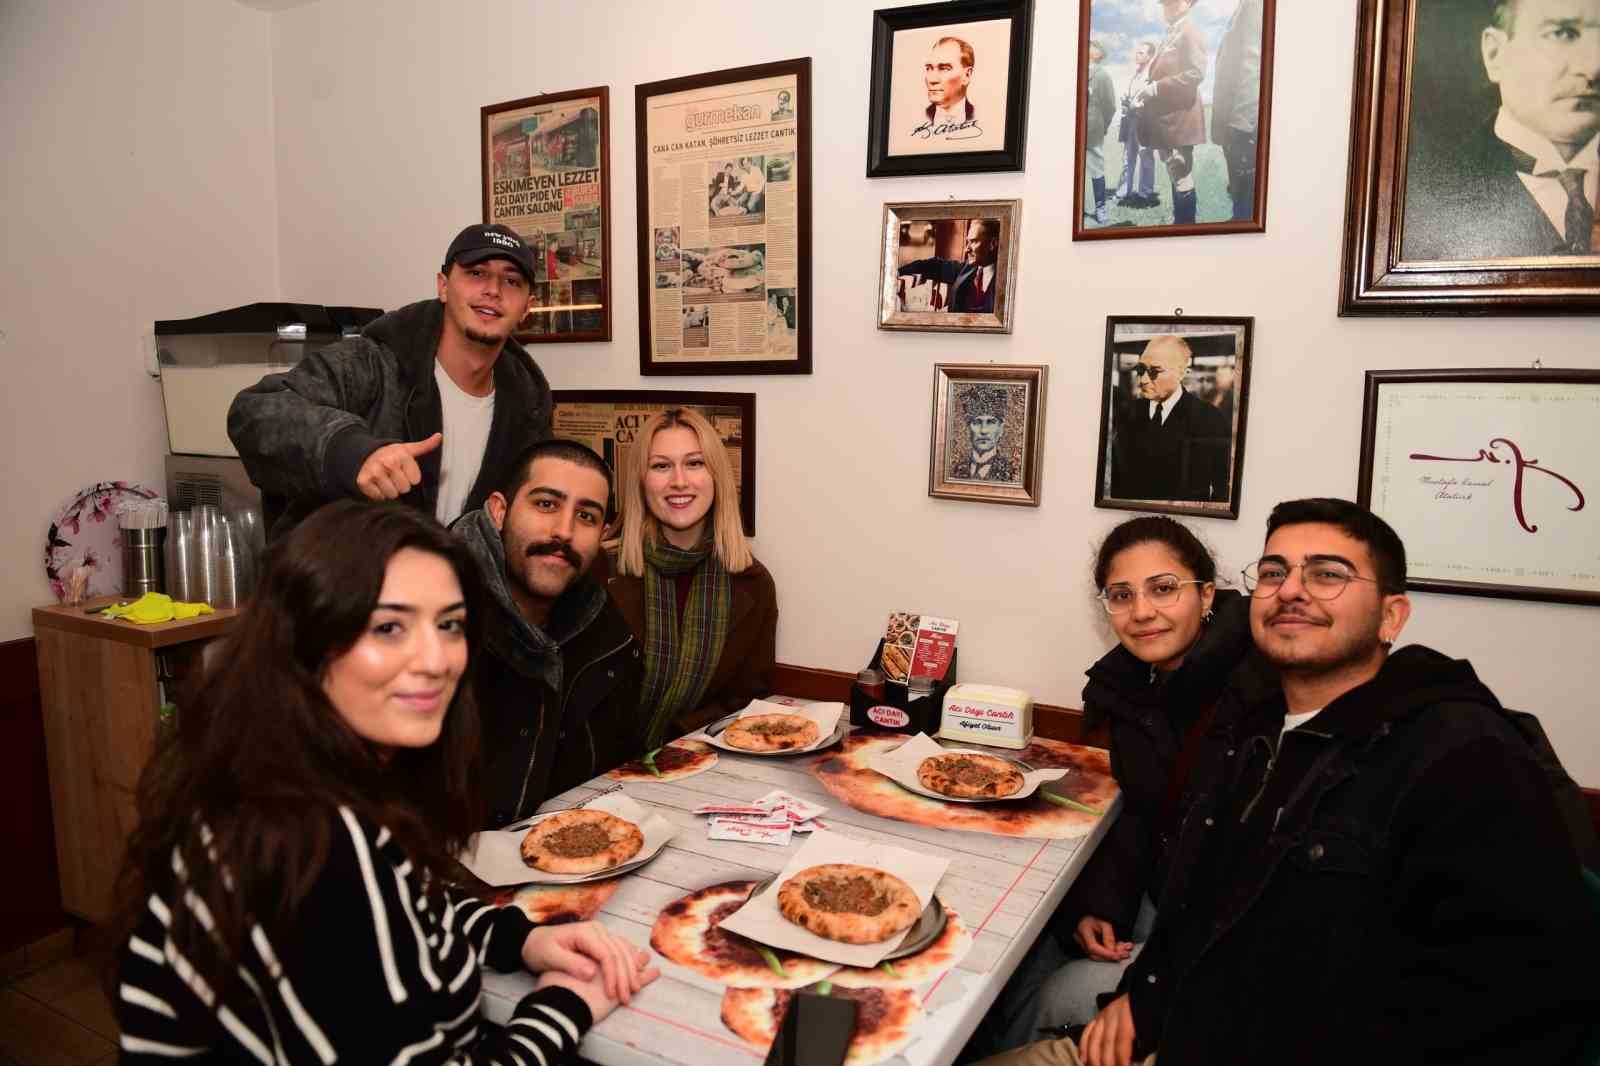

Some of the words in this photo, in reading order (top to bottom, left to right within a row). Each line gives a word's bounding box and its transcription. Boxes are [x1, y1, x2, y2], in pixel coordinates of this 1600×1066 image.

[559, 168, 599, 186] LEZZET
[551, 188, 563, 200] VE
[526, 200, 563, 215] SALONU
